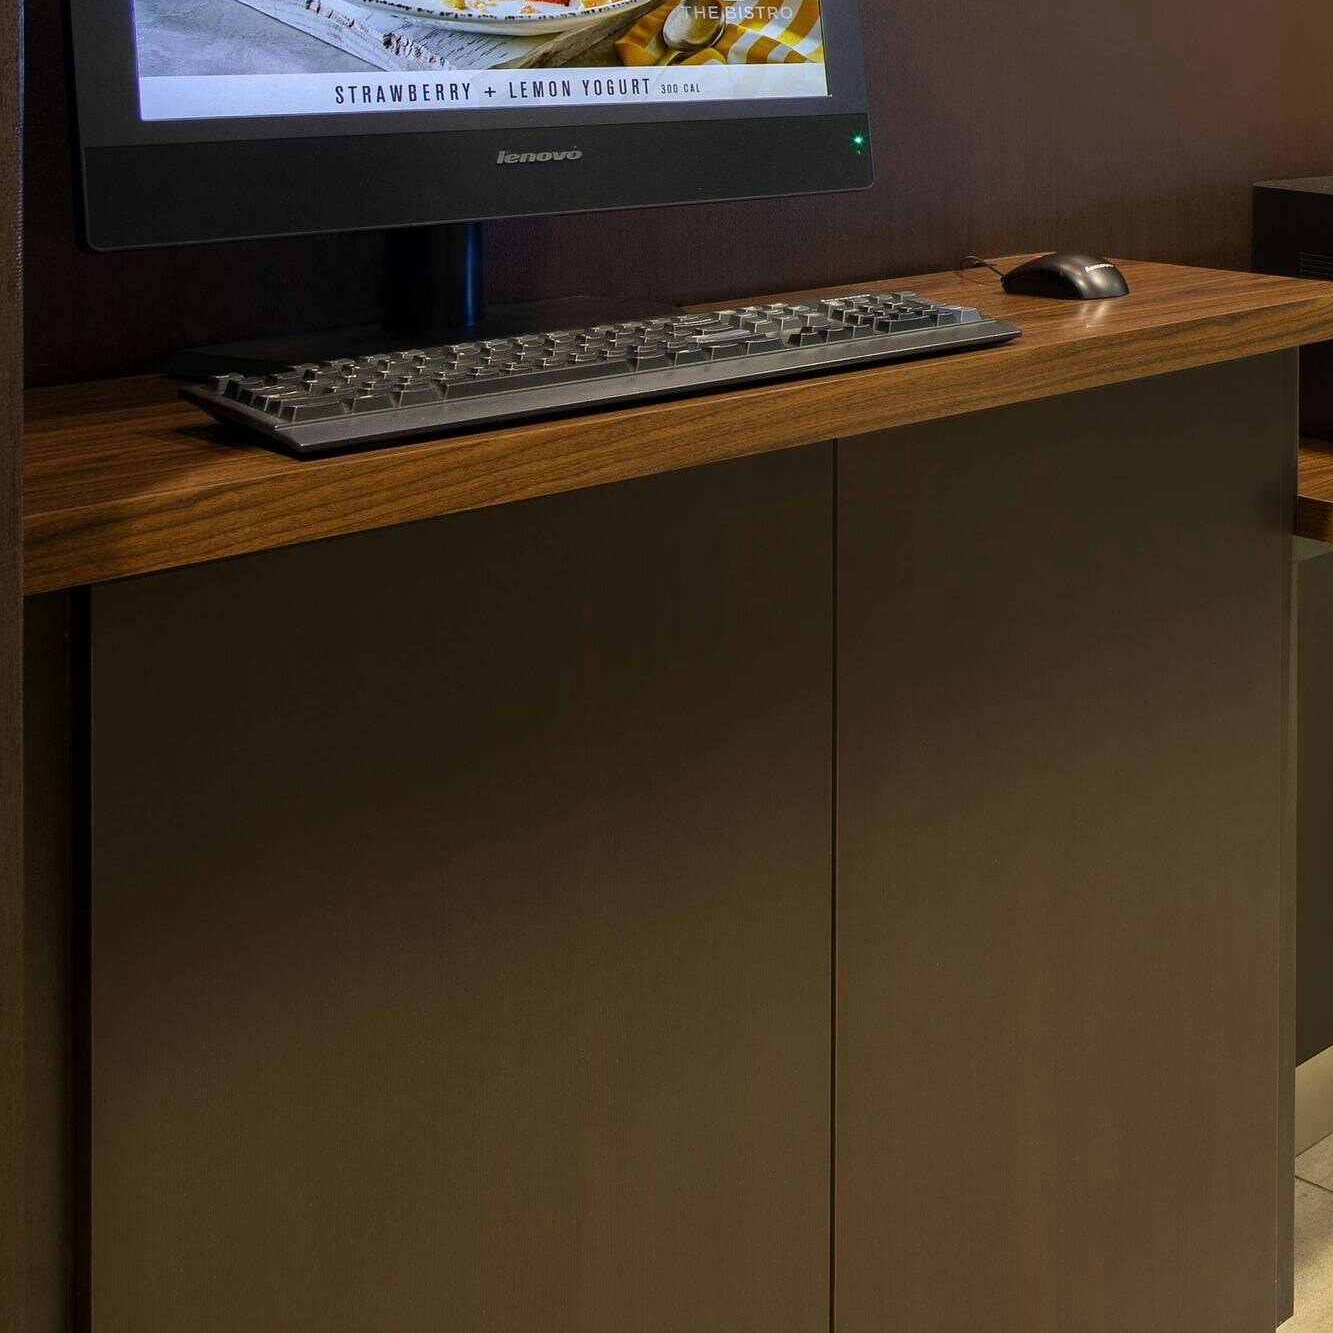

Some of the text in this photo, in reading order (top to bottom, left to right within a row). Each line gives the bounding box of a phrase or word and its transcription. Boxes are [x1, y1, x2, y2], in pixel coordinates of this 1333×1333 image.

[681, 6, 793, 19] THE BISTRO
[335, 77, 701, 104] STRAWBERRY + LEMON YOGURT 300 CAL
[497, 149, 583, 165] lenovo
